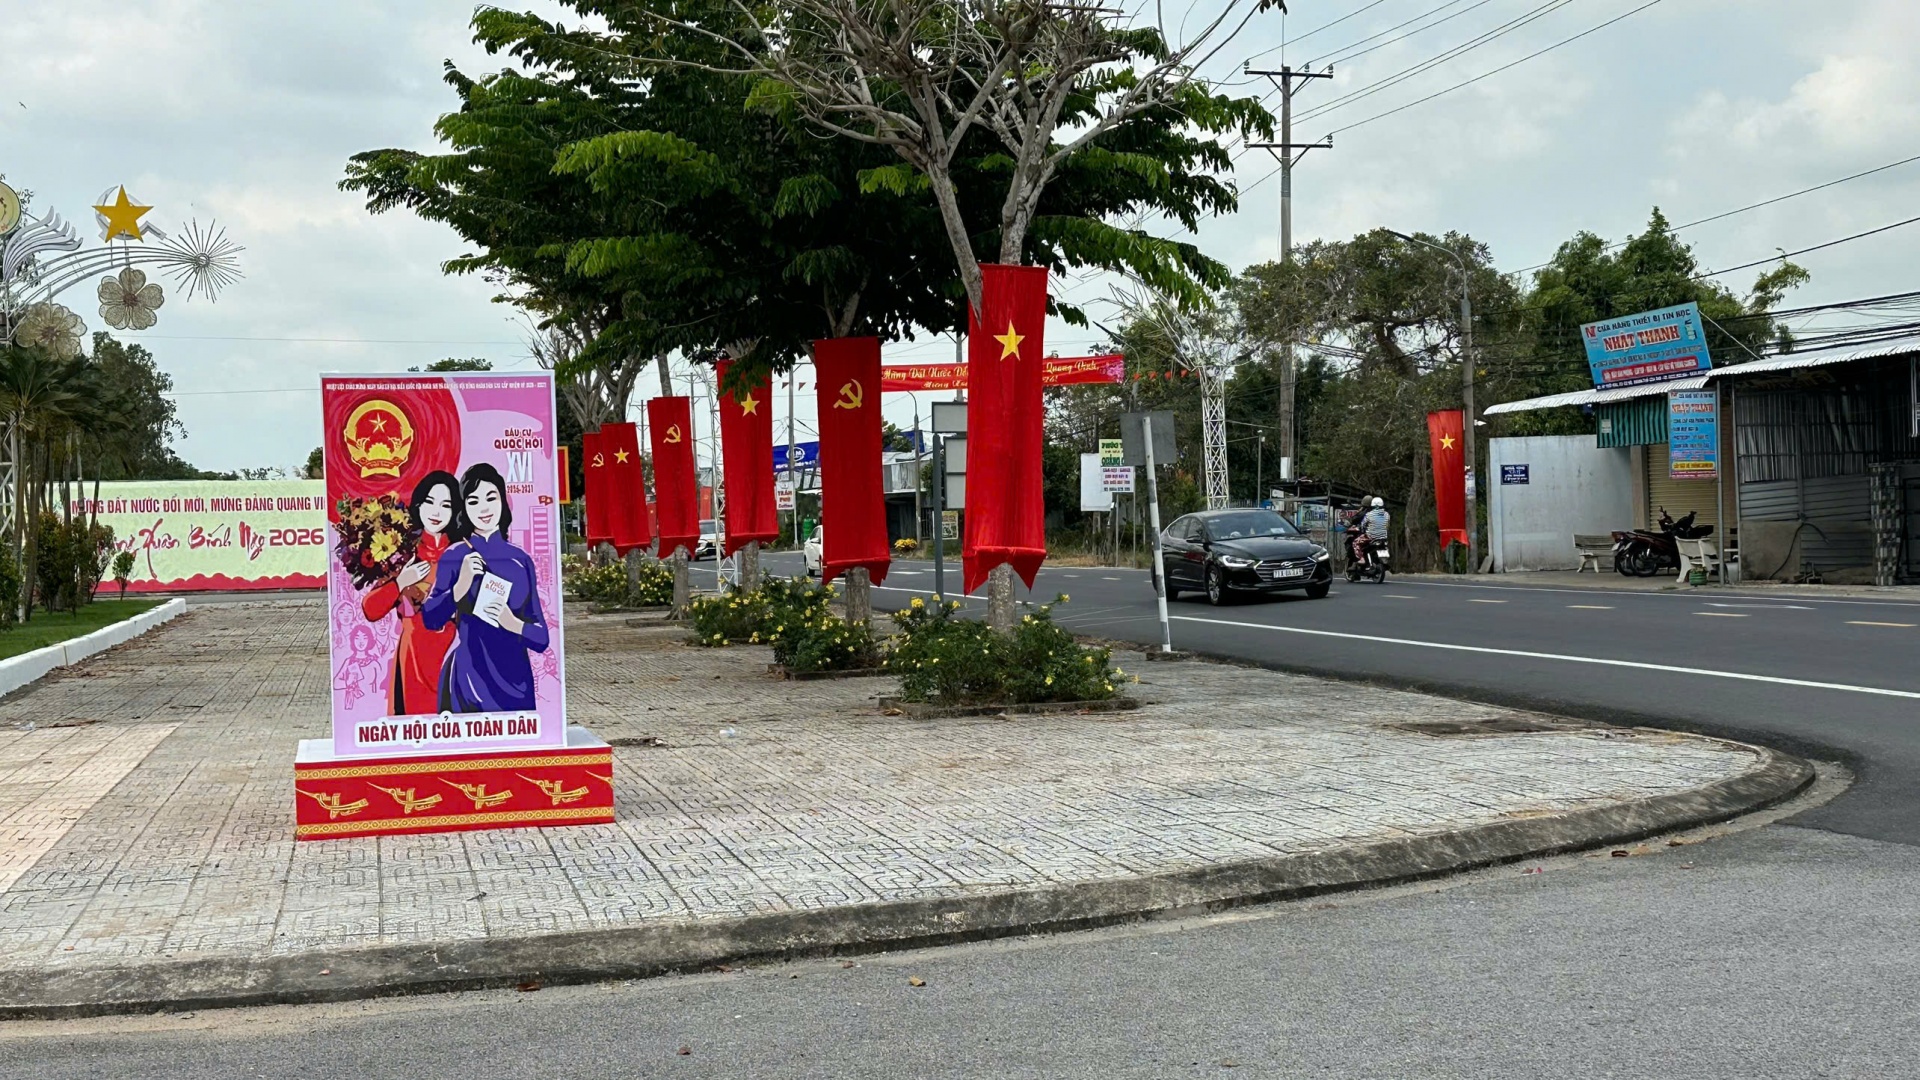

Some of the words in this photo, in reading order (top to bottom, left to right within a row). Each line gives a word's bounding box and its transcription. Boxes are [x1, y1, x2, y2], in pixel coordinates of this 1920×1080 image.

[1602, 331, 1636, 353] NHẬT
[1637, 324, 1680, 345] THANH
[506, 451, 533, 483] XVI
[107, 494, 128, 514] ĐẤT
[131, 496, 160, 514] NƯỚC
[163, 493, 181, 513] ĐỔI
[211, 494, 242, 513] MỪNG
[245, 492, 273, 512] ĐẢNG
[277, 496, 310, 513] QUANG
[269, 528, 325, 546] 2026
[359, 722, 398, 743] NGÀY
[403, 720, 427, 743] HỘI
[432, 715, 461, 739] CỦA
[465, 717, 503, 737] TOÀN
[507, 715, 537, 735] DÂN
